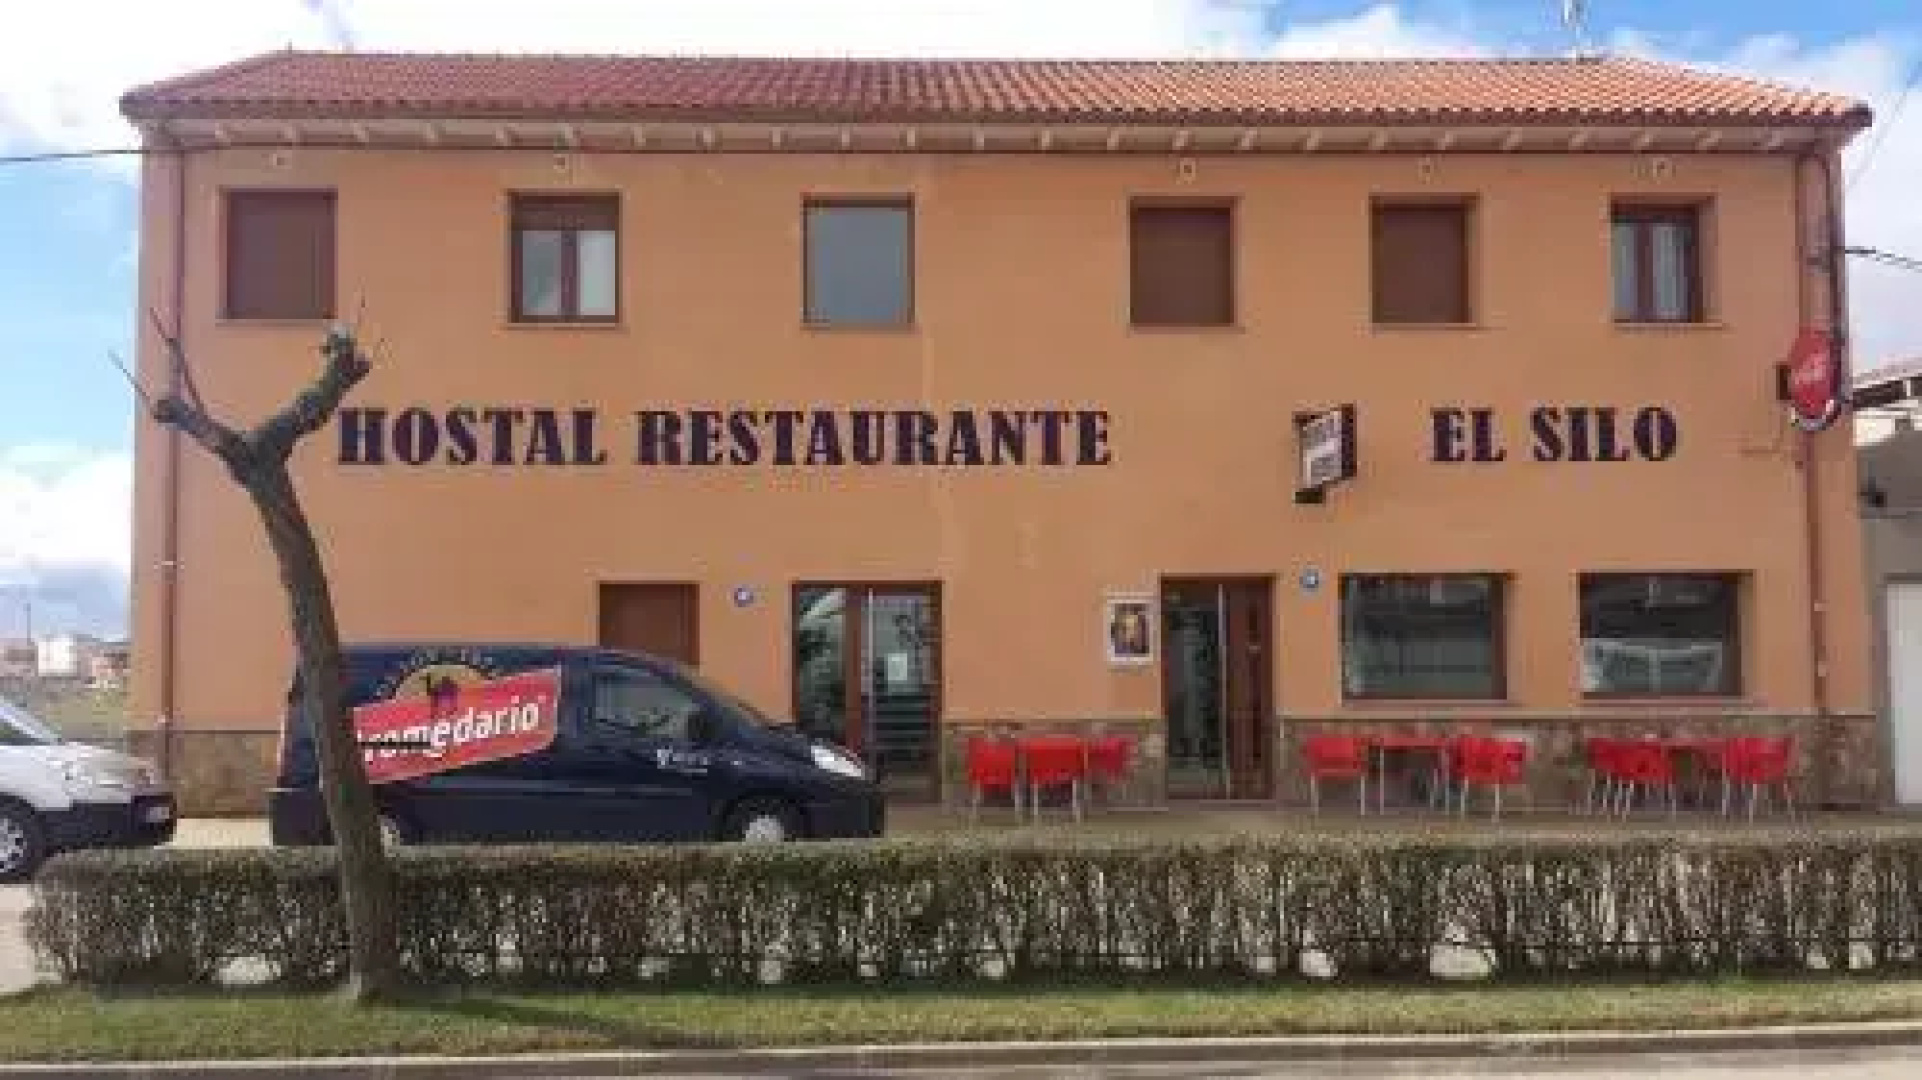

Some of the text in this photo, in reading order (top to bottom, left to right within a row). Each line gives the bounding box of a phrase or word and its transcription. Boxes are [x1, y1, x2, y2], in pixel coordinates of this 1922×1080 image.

[337, 407, 1677, 466] HOSTAL RESTAURANTE EL SILO
[356, 695, 540, 763] romedario
